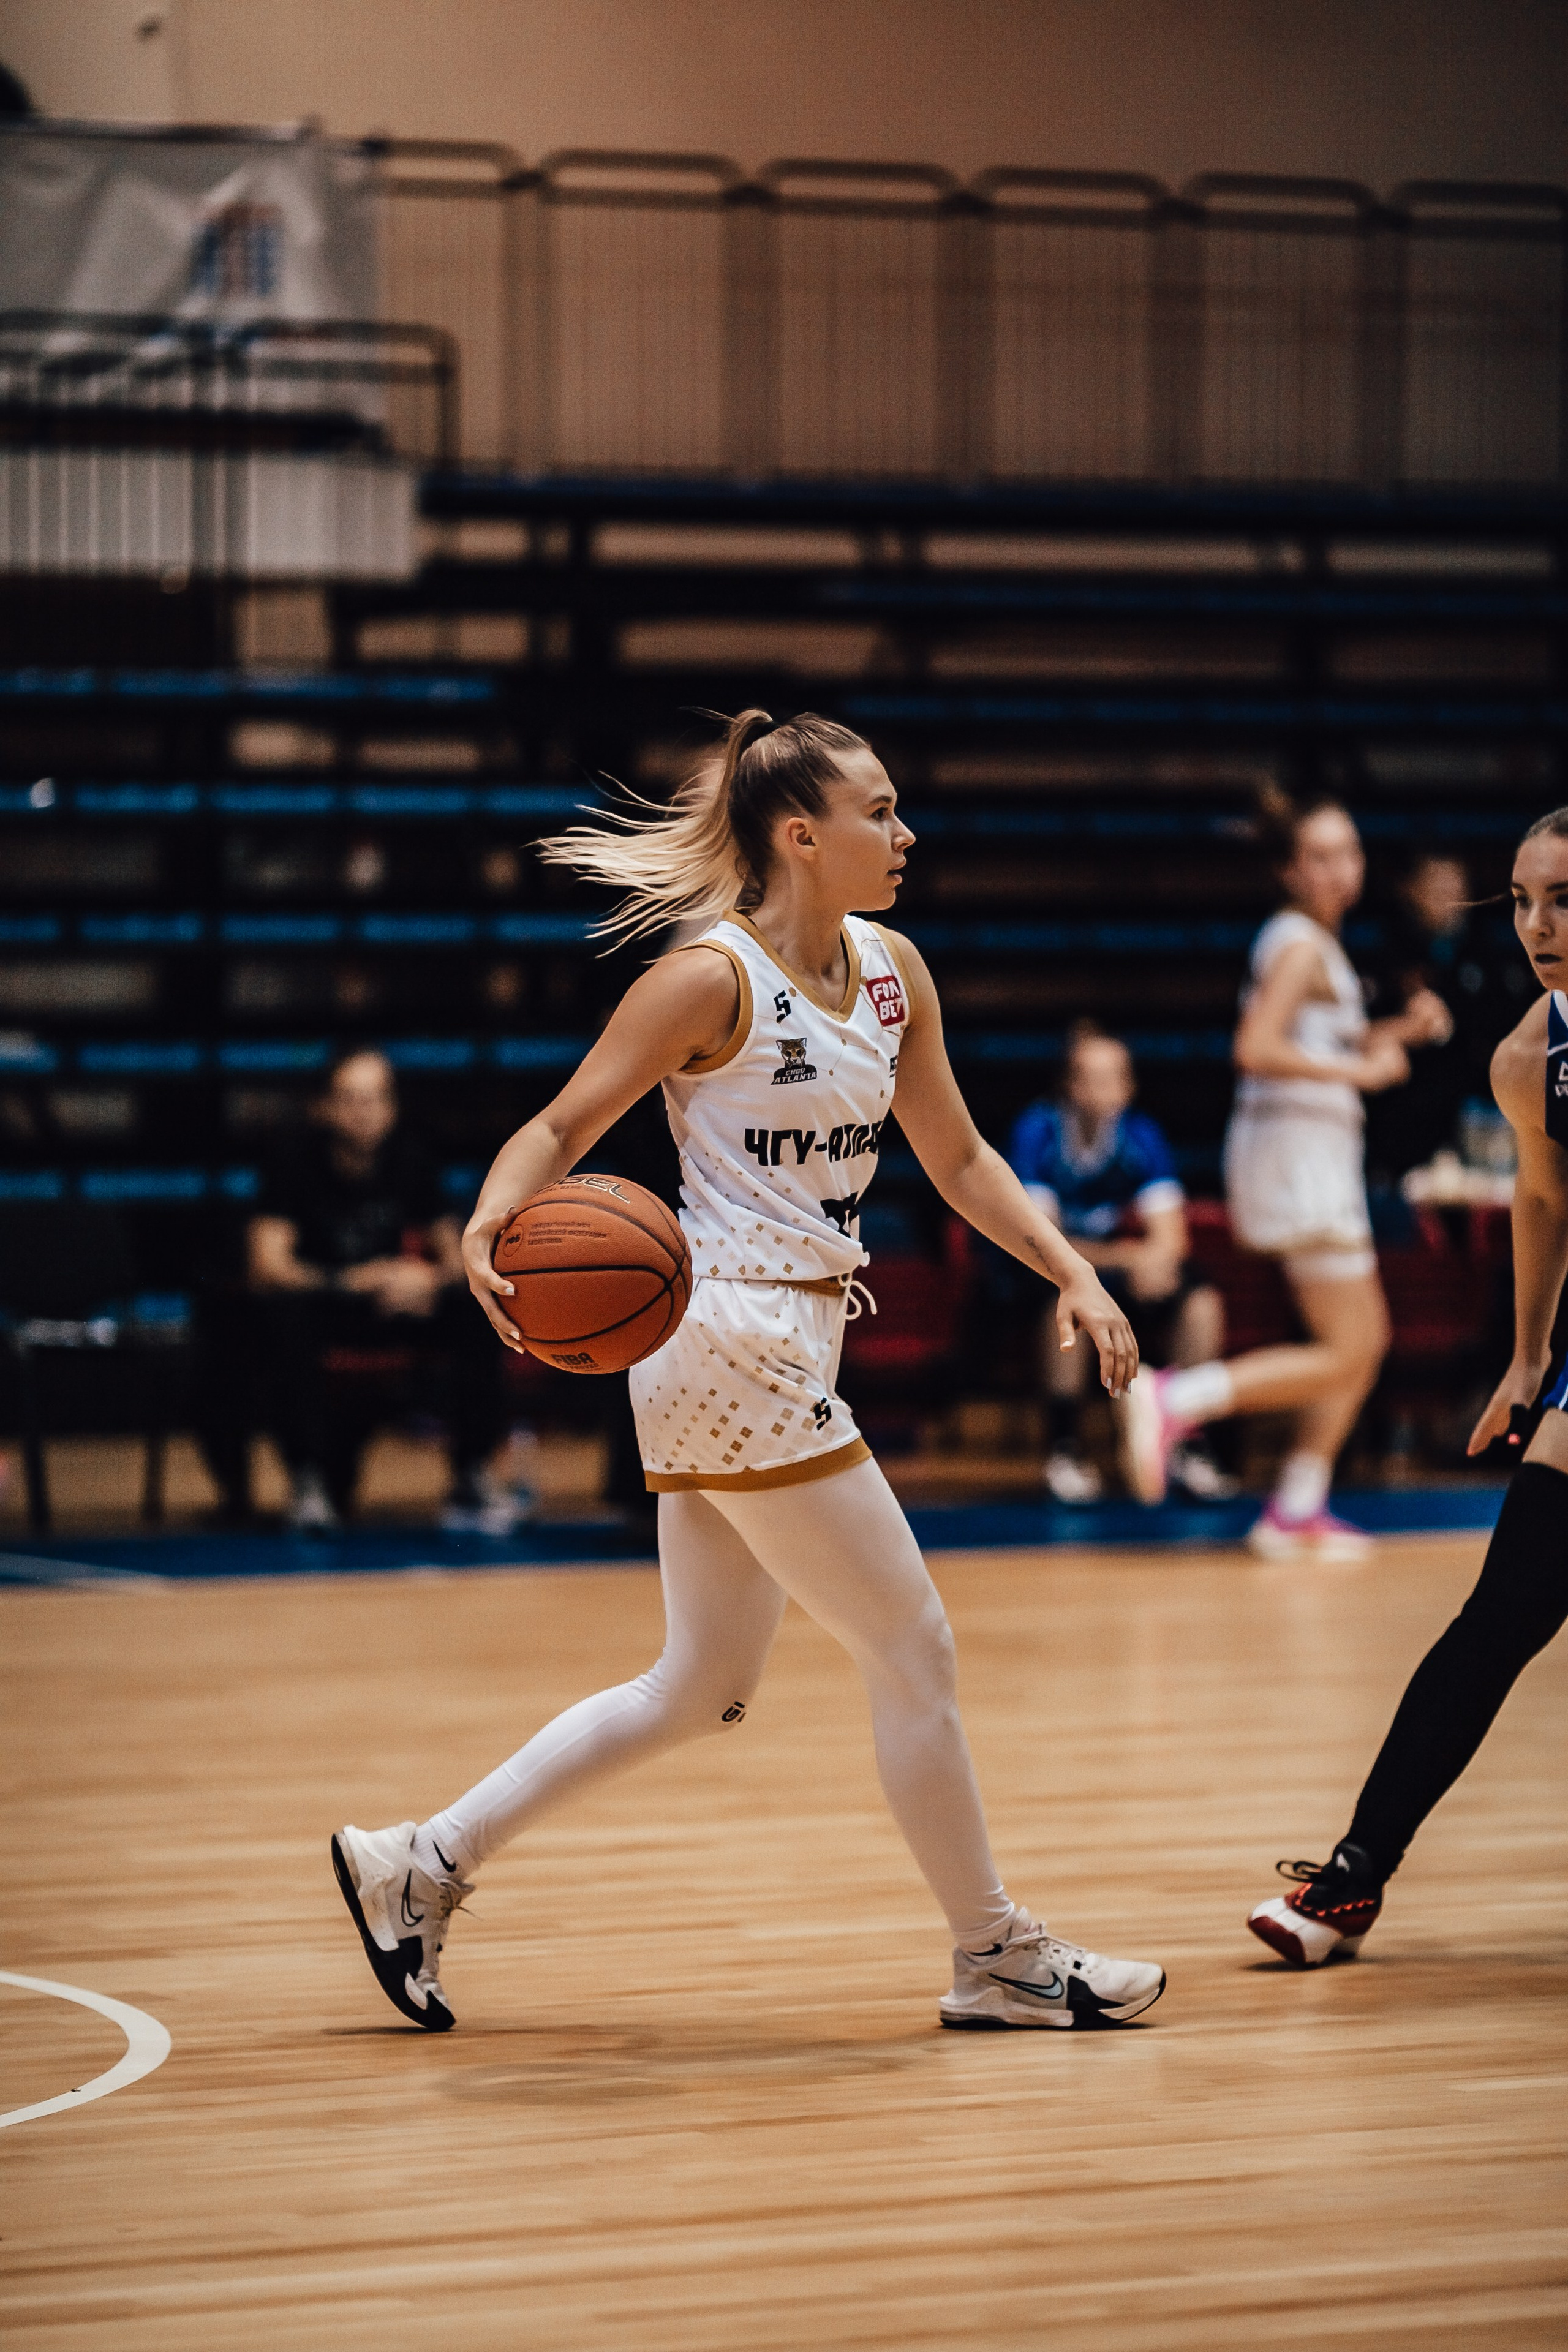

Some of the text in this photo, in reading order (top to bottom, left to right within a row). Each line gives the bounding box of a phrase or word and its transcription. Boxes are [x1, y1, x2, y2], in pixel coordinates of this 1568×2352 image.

[872, 980, 900, 1002] FON
[879, 997, 903, 1020] BET
[774, 1071, 817, 1084] ATLANTA
[550, 1352, 595, 1366] FIBA
